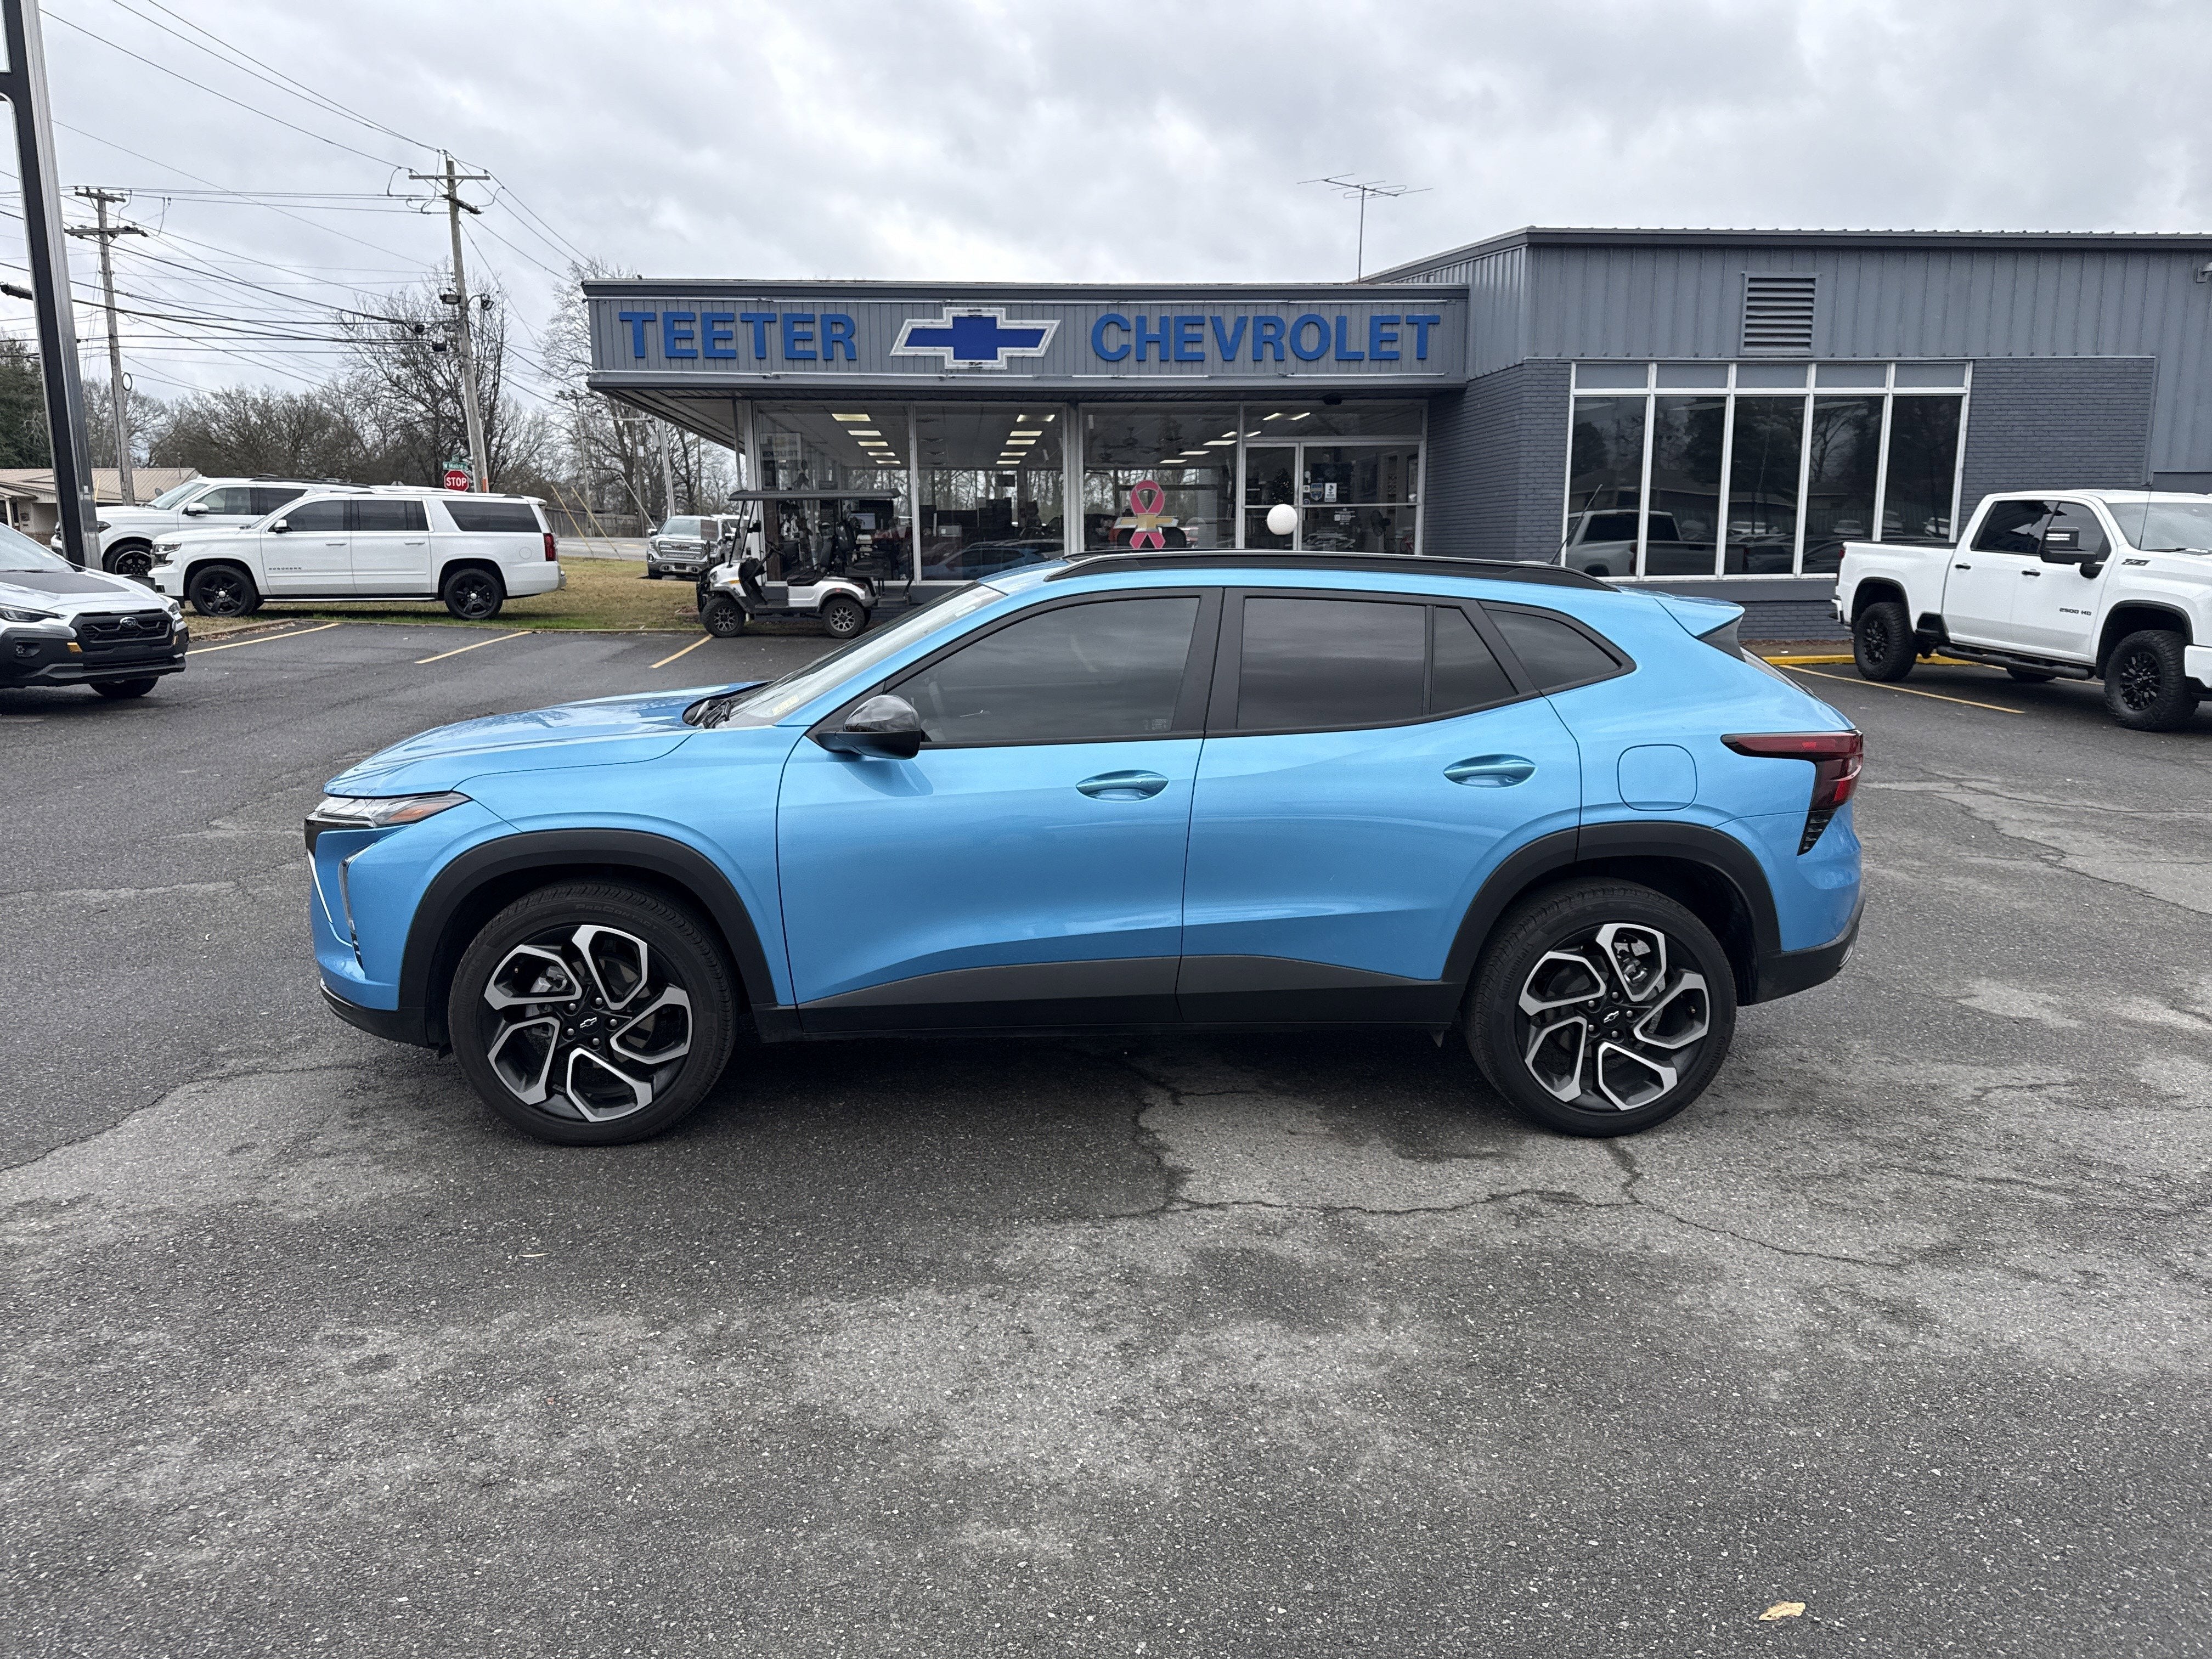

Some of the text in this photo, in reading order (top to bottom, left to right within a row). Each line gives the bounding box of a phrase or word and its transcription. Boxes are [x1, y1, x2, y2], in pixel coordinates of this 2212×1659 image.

[619, 311, 1441, 361] TEETER CHEVROLET
[446, 477, 467, 487] STOP
